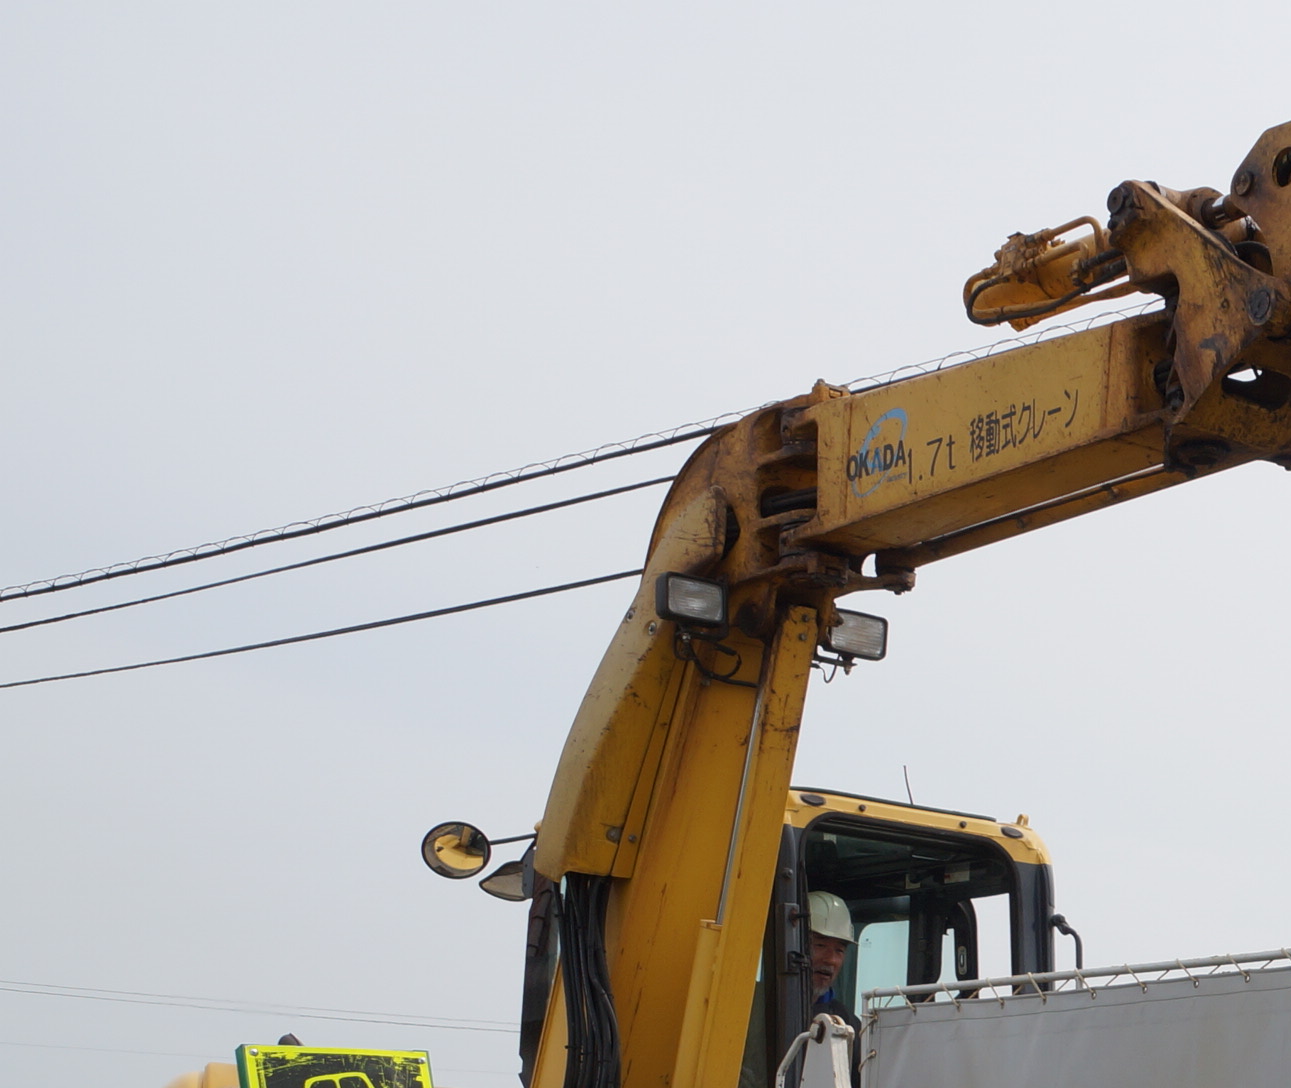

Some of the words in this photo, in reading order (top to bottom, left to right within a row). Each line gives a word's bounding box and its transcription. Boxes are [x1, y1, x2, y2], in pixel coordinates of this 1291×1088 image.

[846, 440, 906, 482] OKADA
[906, 434, 956, 484] 1.7t
[969, 388, 1079, 463] 移動式クレーン
